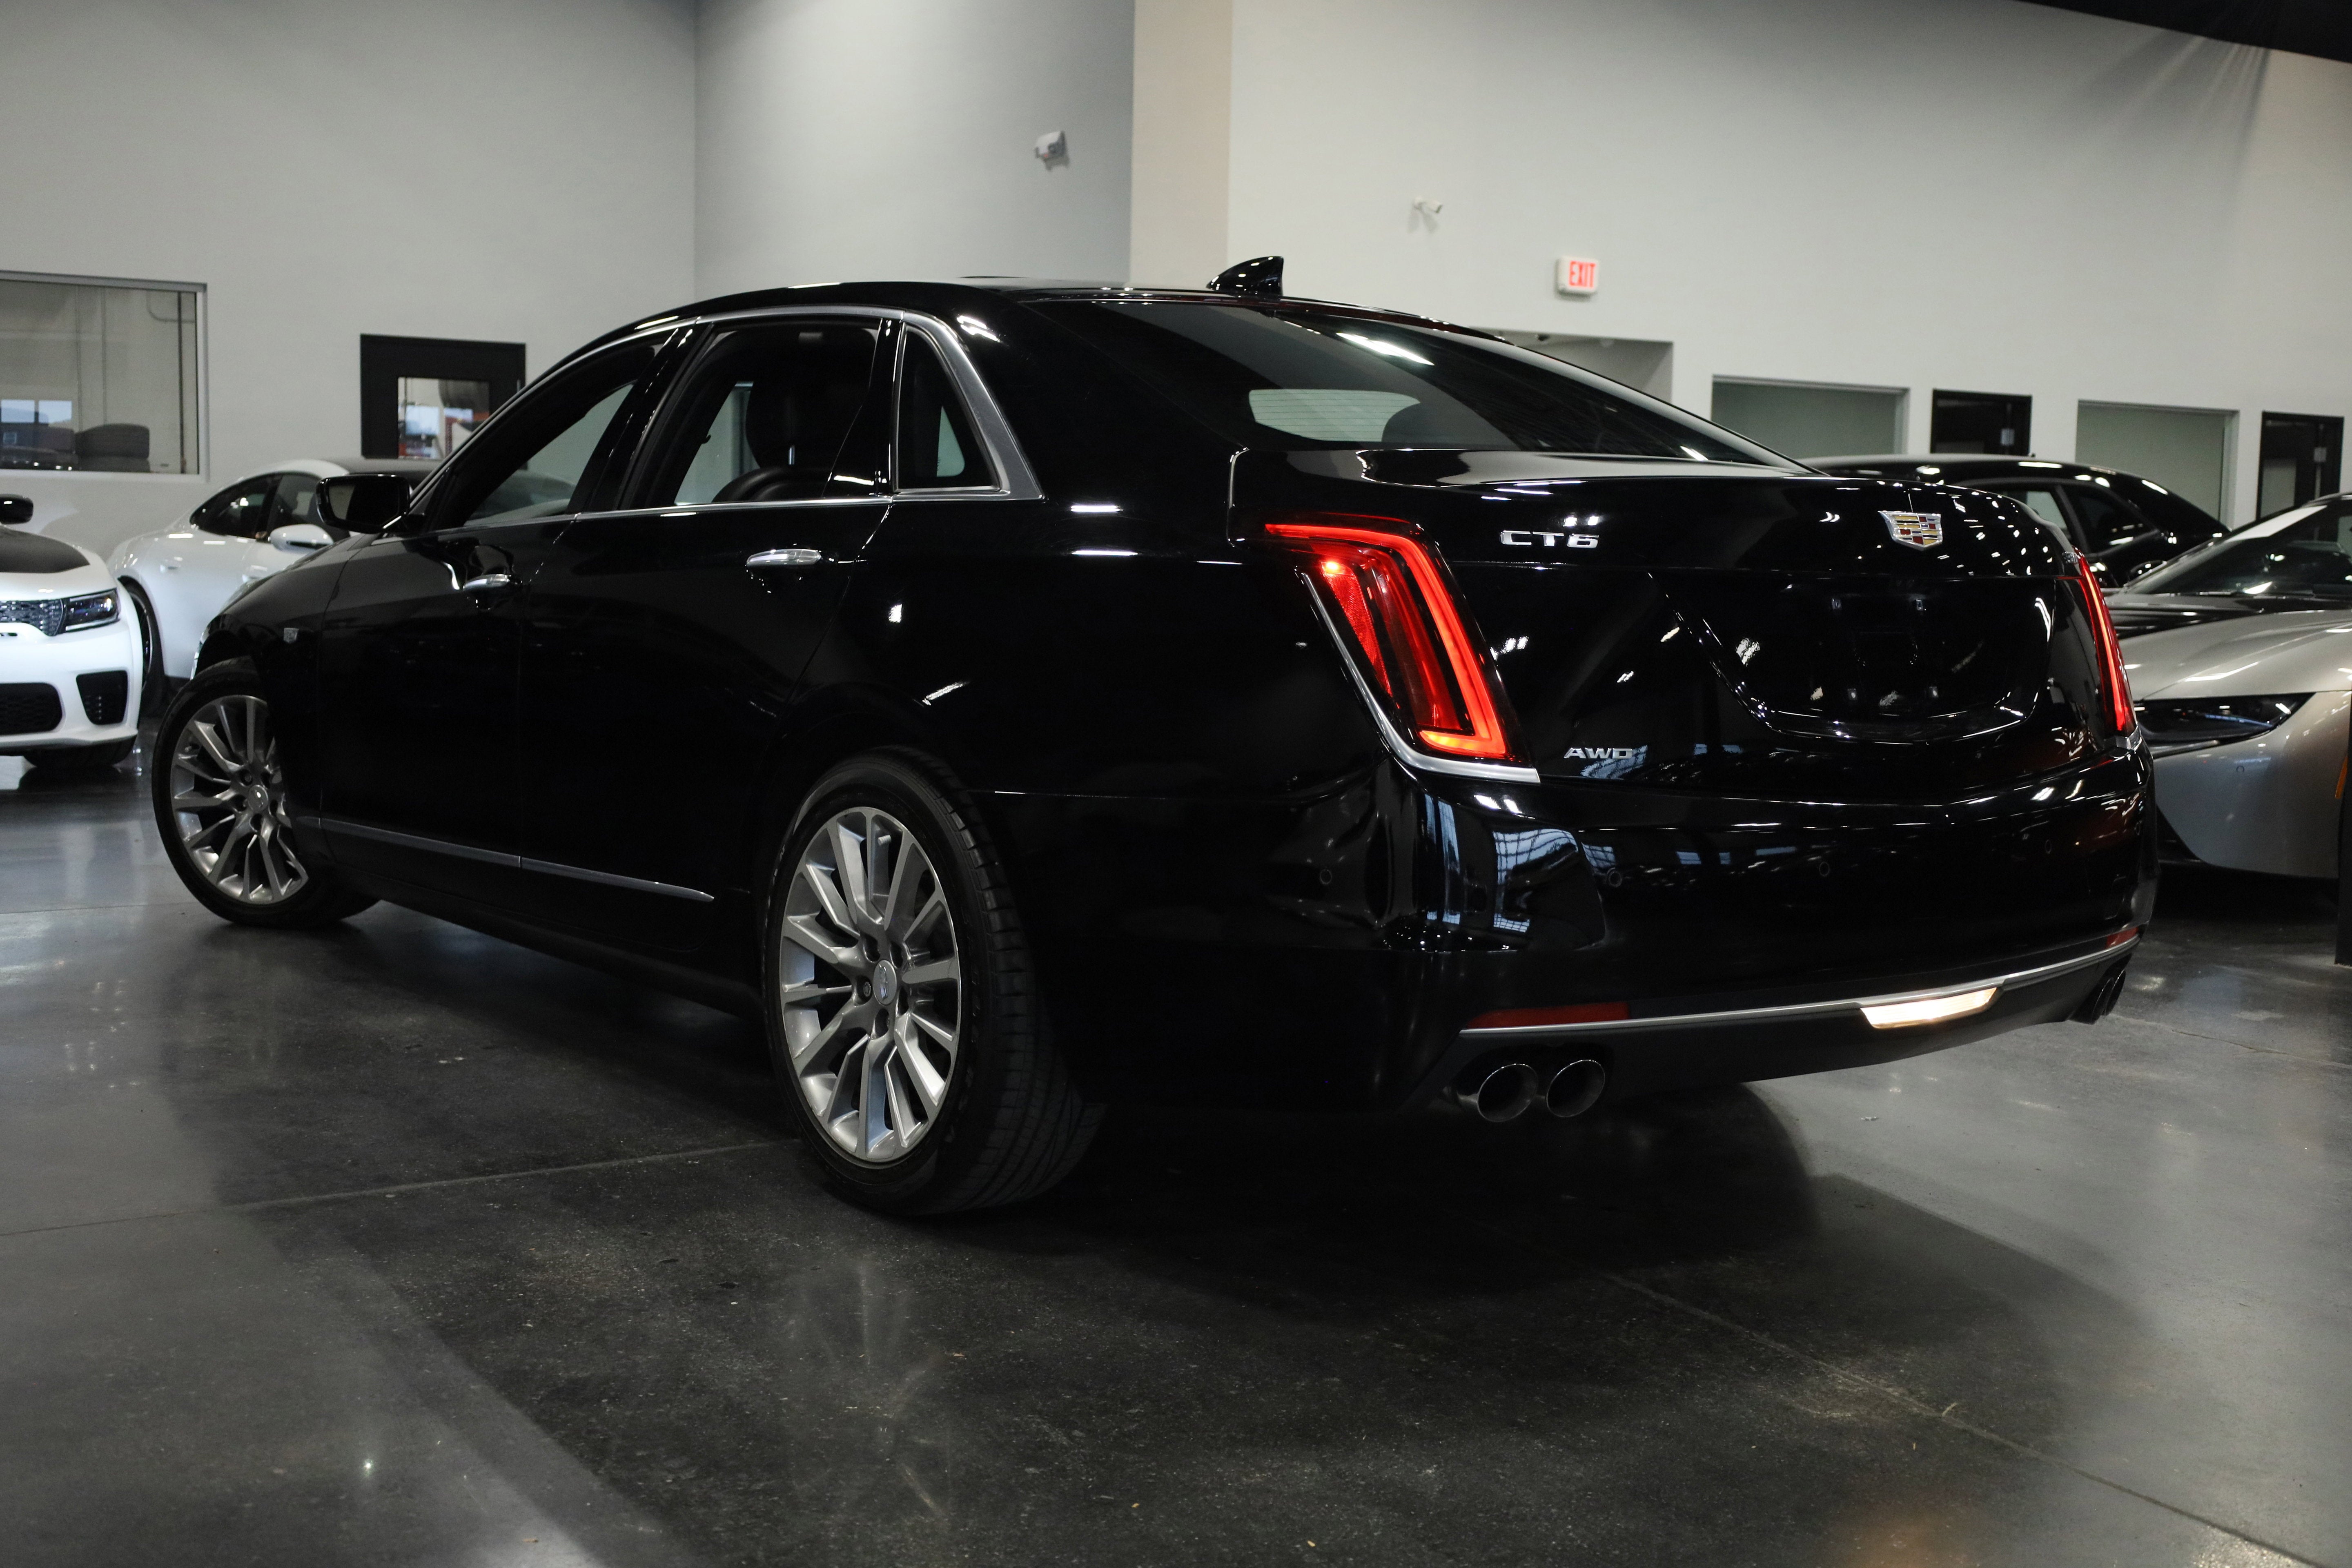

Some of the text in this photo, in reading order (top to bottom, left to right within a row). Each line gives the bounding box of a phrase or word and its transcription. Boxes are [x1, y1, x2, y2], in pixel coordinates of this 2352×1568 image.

[1569, 261, 1596, 288] EXIT
[1500, 530, 1599, 548] CT6
[1564, 747, 1633, 759] AWD
